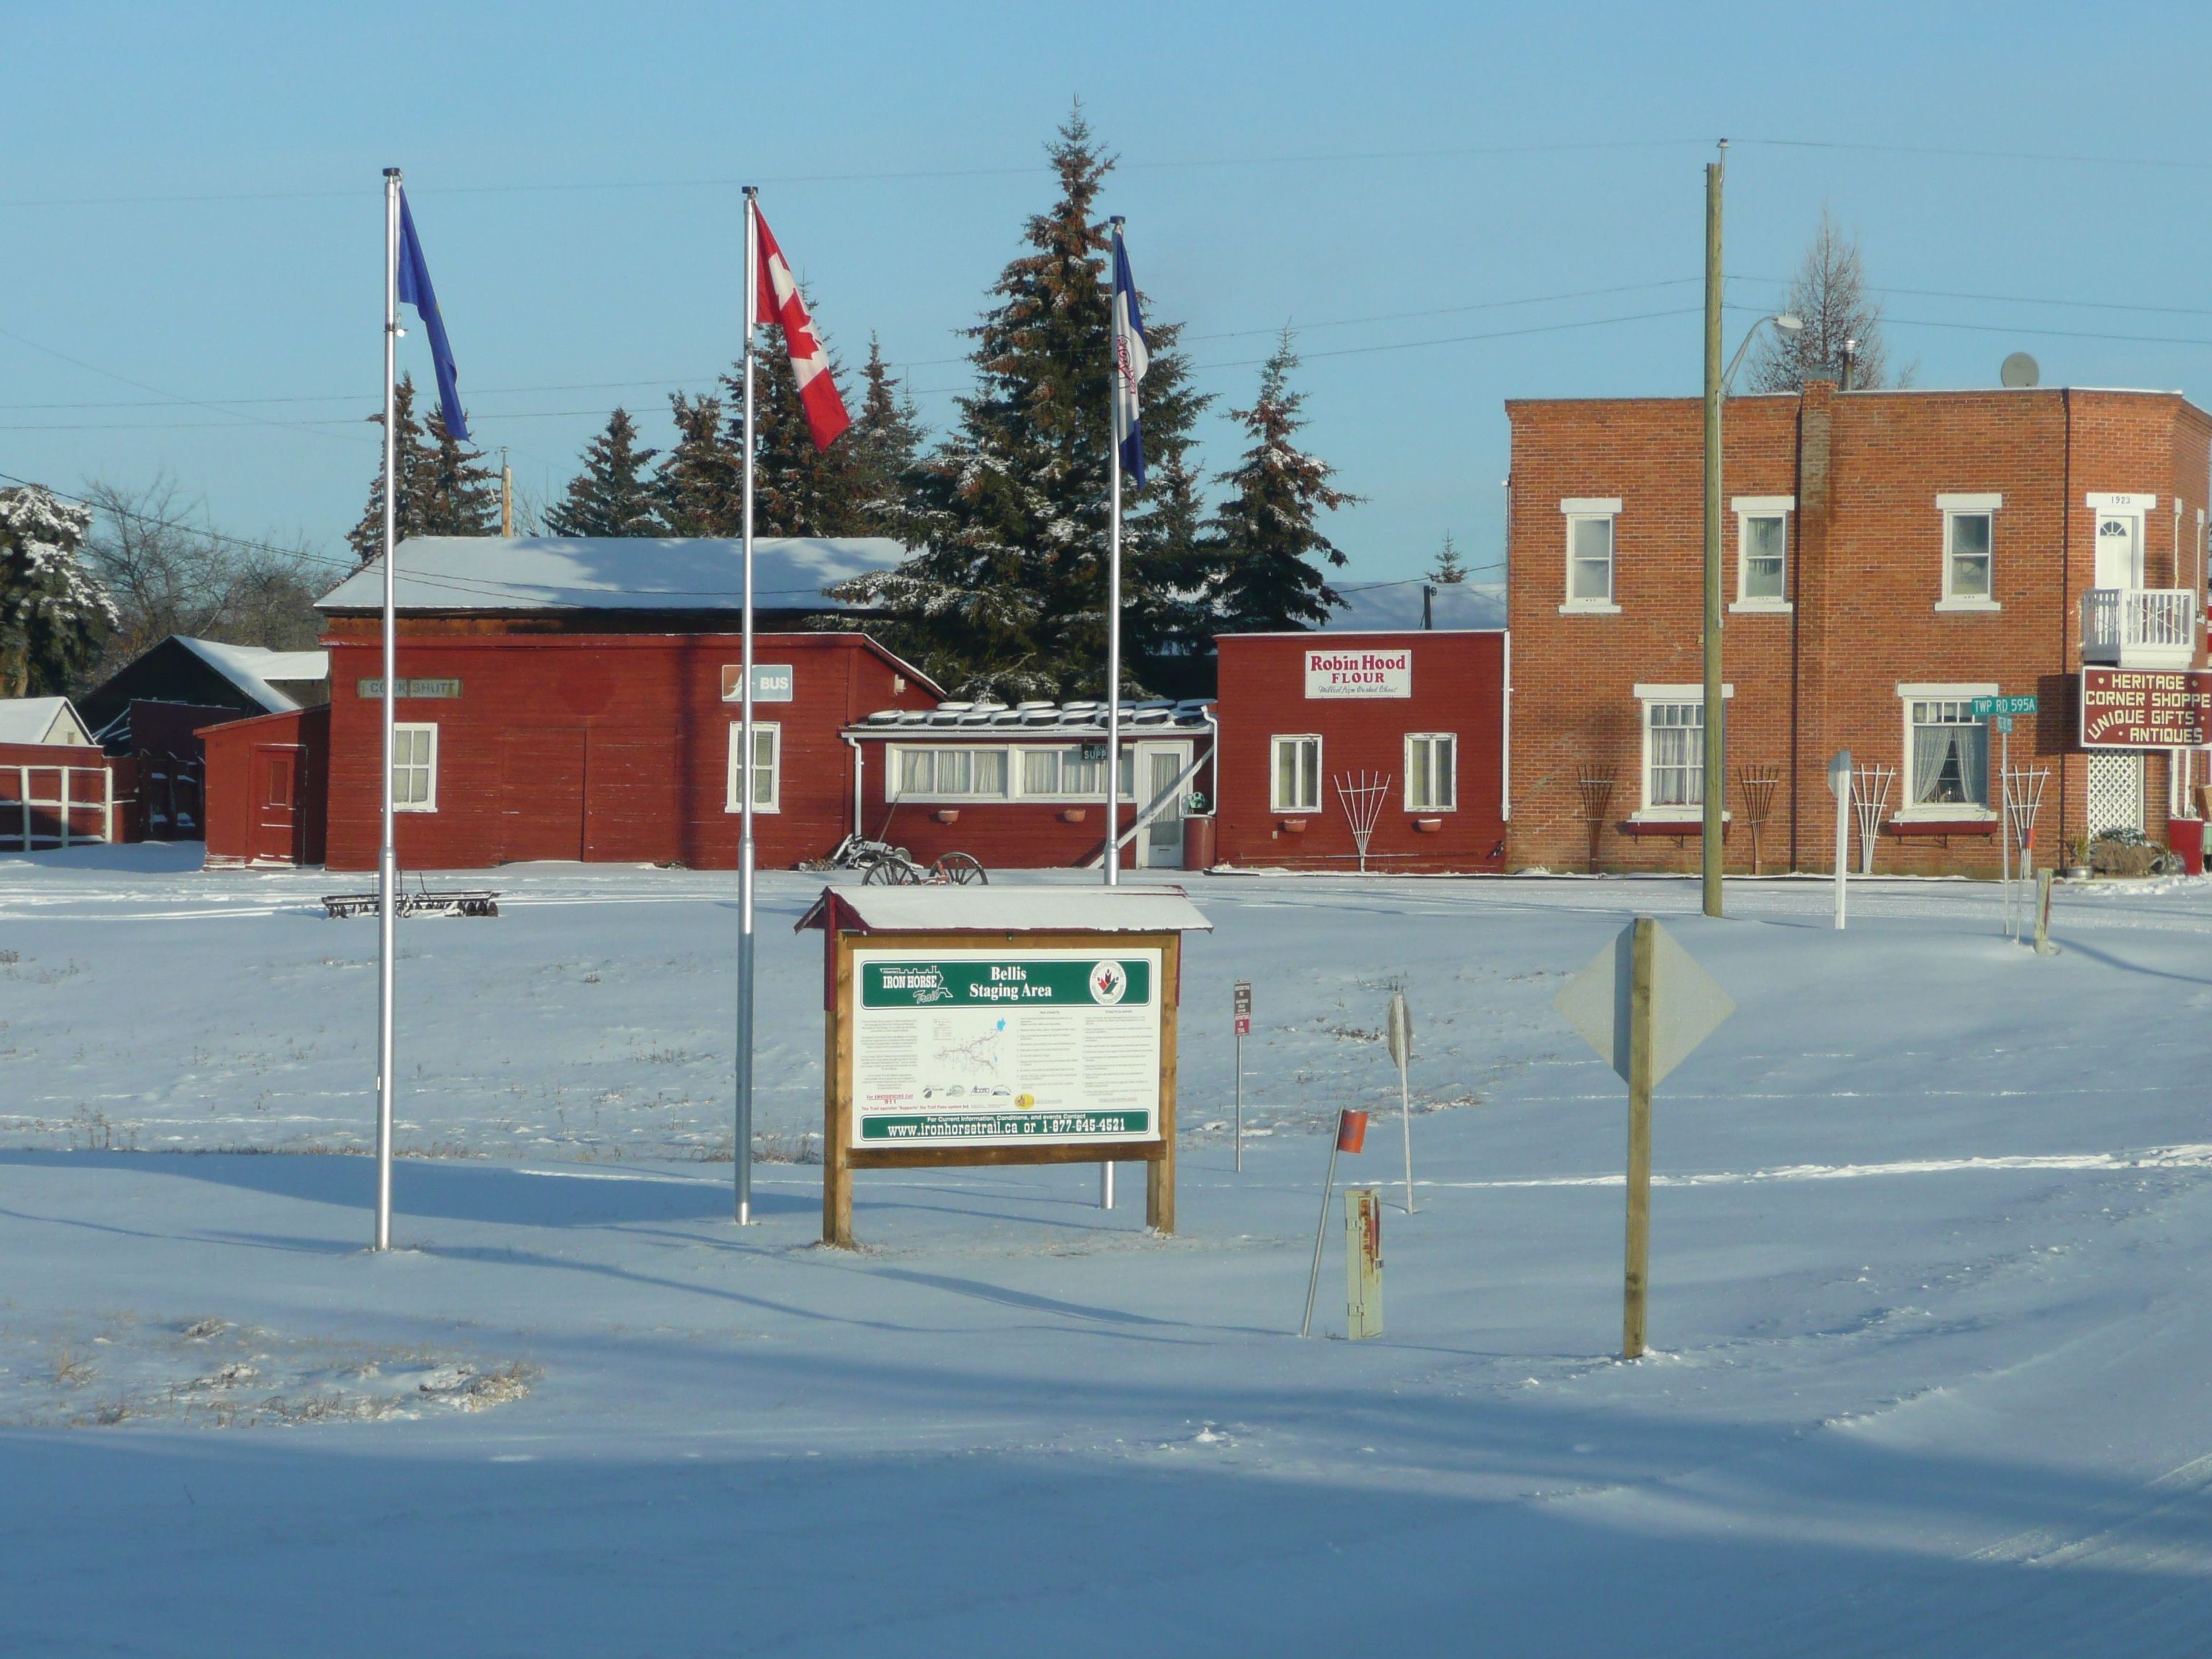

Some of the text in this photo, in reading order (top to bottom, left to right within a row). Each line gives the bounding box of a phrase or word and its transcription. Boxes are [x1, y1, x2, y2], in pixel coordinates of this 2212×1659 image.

[2111, 496, 2131, 504] 1923
[1310, 654, 1406, 671] Robin Hood
[760, 677, 789, 690] BUS
[1332, 672, 1385, 684] FLOUR
[2112, 673, 2186, 690] HERITAGE
[1974, 698, 2035, 713] TWP RD 595A
[2085, 691, 2211, 708] CORNER SHOPPE
[2088, 709, 2195, 740] UNIQUE GIFTS
[2130, 728, 2203, 743] ANTIQUES
[991, 966, 1027, 980] Bellis
[883, 975, 937, 988] IRON HORSE
[912, 989, 939, 1004] Trail
[969, 983, 1052, 1001] Staging Area
[888, 1118, 1125, 1137] www.ironhorsetrail.ca or 1-877-645-4521
